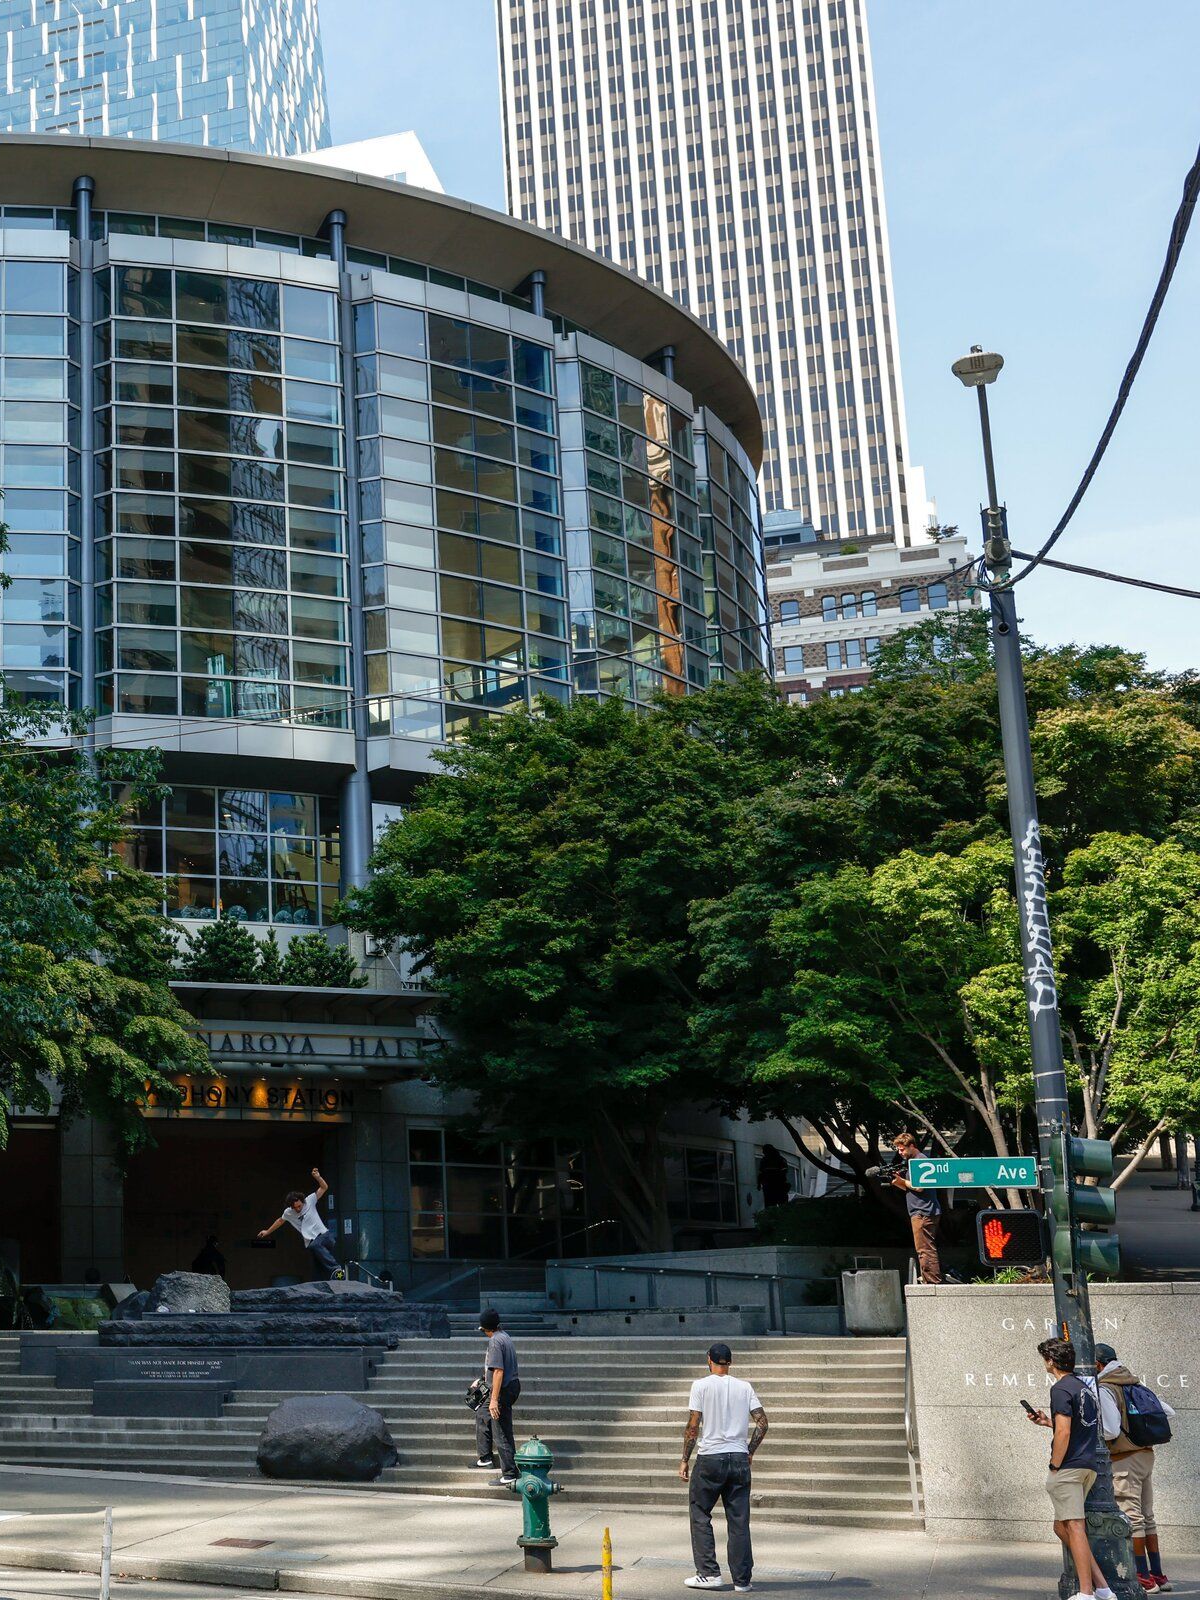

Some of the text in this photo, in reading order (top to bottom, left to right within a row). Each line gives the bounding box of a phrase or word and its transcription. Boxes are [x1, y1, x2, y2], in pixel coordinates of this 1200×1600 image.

[266, 1086, 354, 1108] STATION
[918, 1162, 1027, 1184] 2nd Ave
